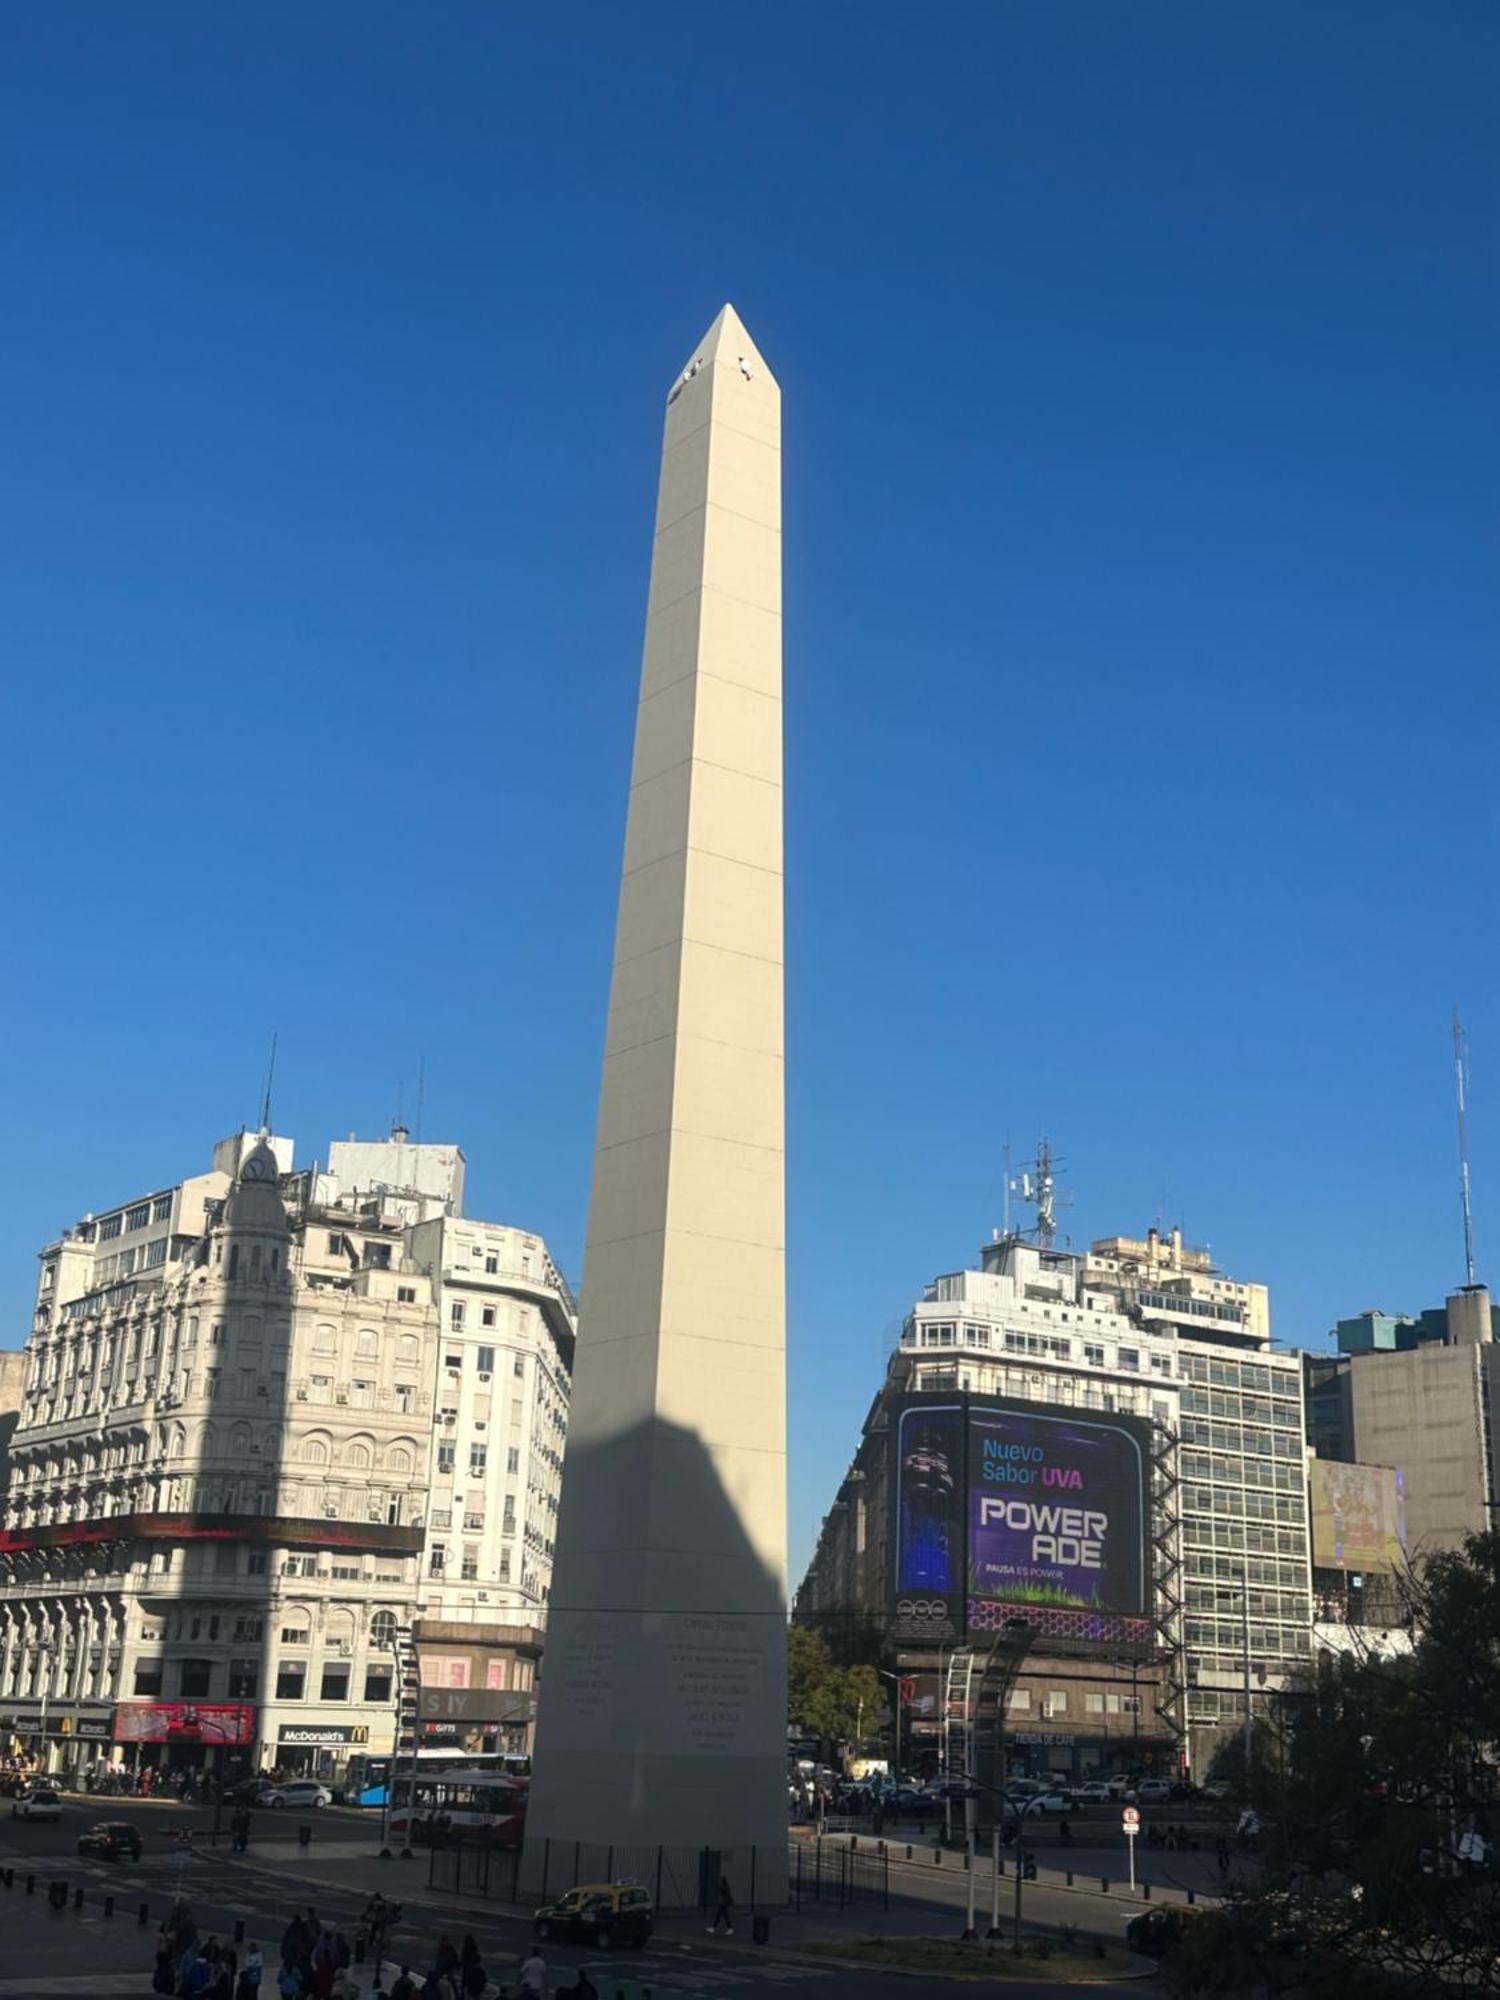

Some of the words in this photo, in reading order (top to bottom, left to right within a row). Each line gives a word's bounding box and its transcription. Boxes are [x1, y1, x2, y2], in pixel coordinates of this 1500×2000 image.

[983, 1439, 1043, 1462] Nuevo
[982, 1461, 1038, 1484] Sabor
[1041, 1466, 1083, 1489] UVA
[981, 1497, 1108, 1540] POWER
[1032, 1534, 1101, 1568] ADE
[985, 1563, 1015, 1575] PAUSA
[284, 1730, 345, 1742] McDonald's
